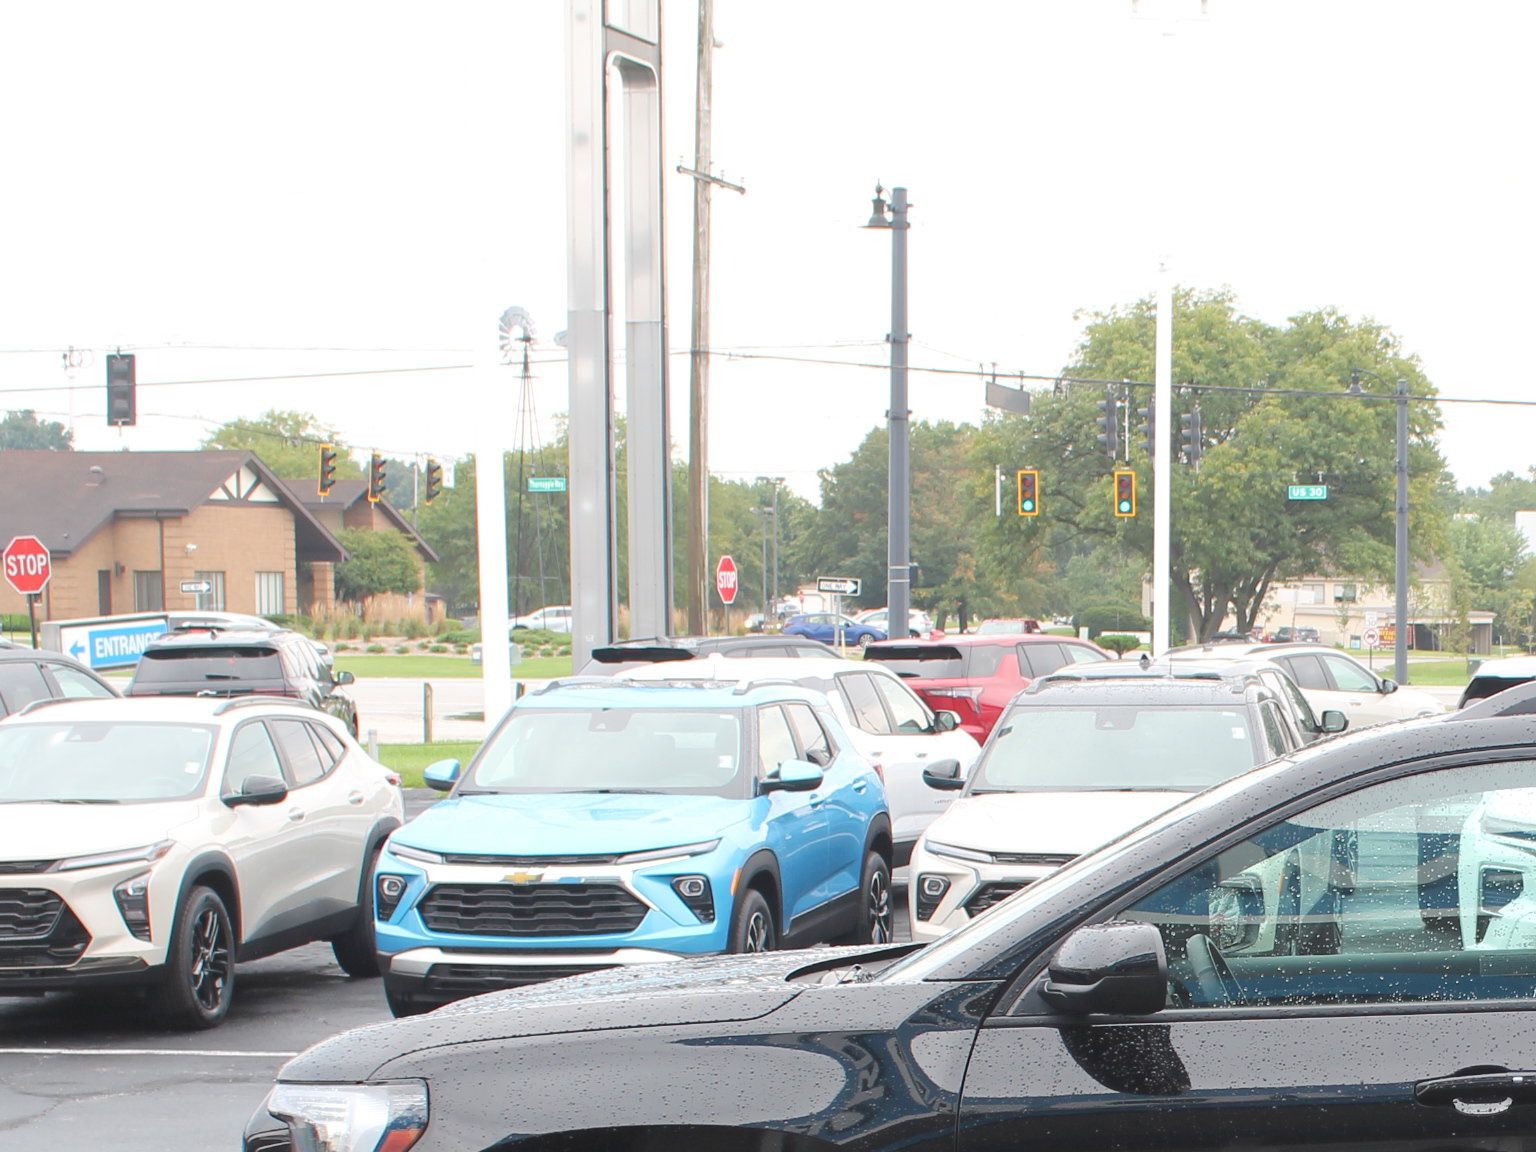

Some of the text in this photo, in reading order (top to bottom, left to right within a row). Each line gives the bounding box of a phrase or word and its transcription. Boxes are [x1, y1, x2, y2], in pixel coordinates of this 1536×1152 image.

[1292, 487, 1323, 497] US 30
[7, 554, 47, 576] STOP
[719, 571, 736, 589] STOP
